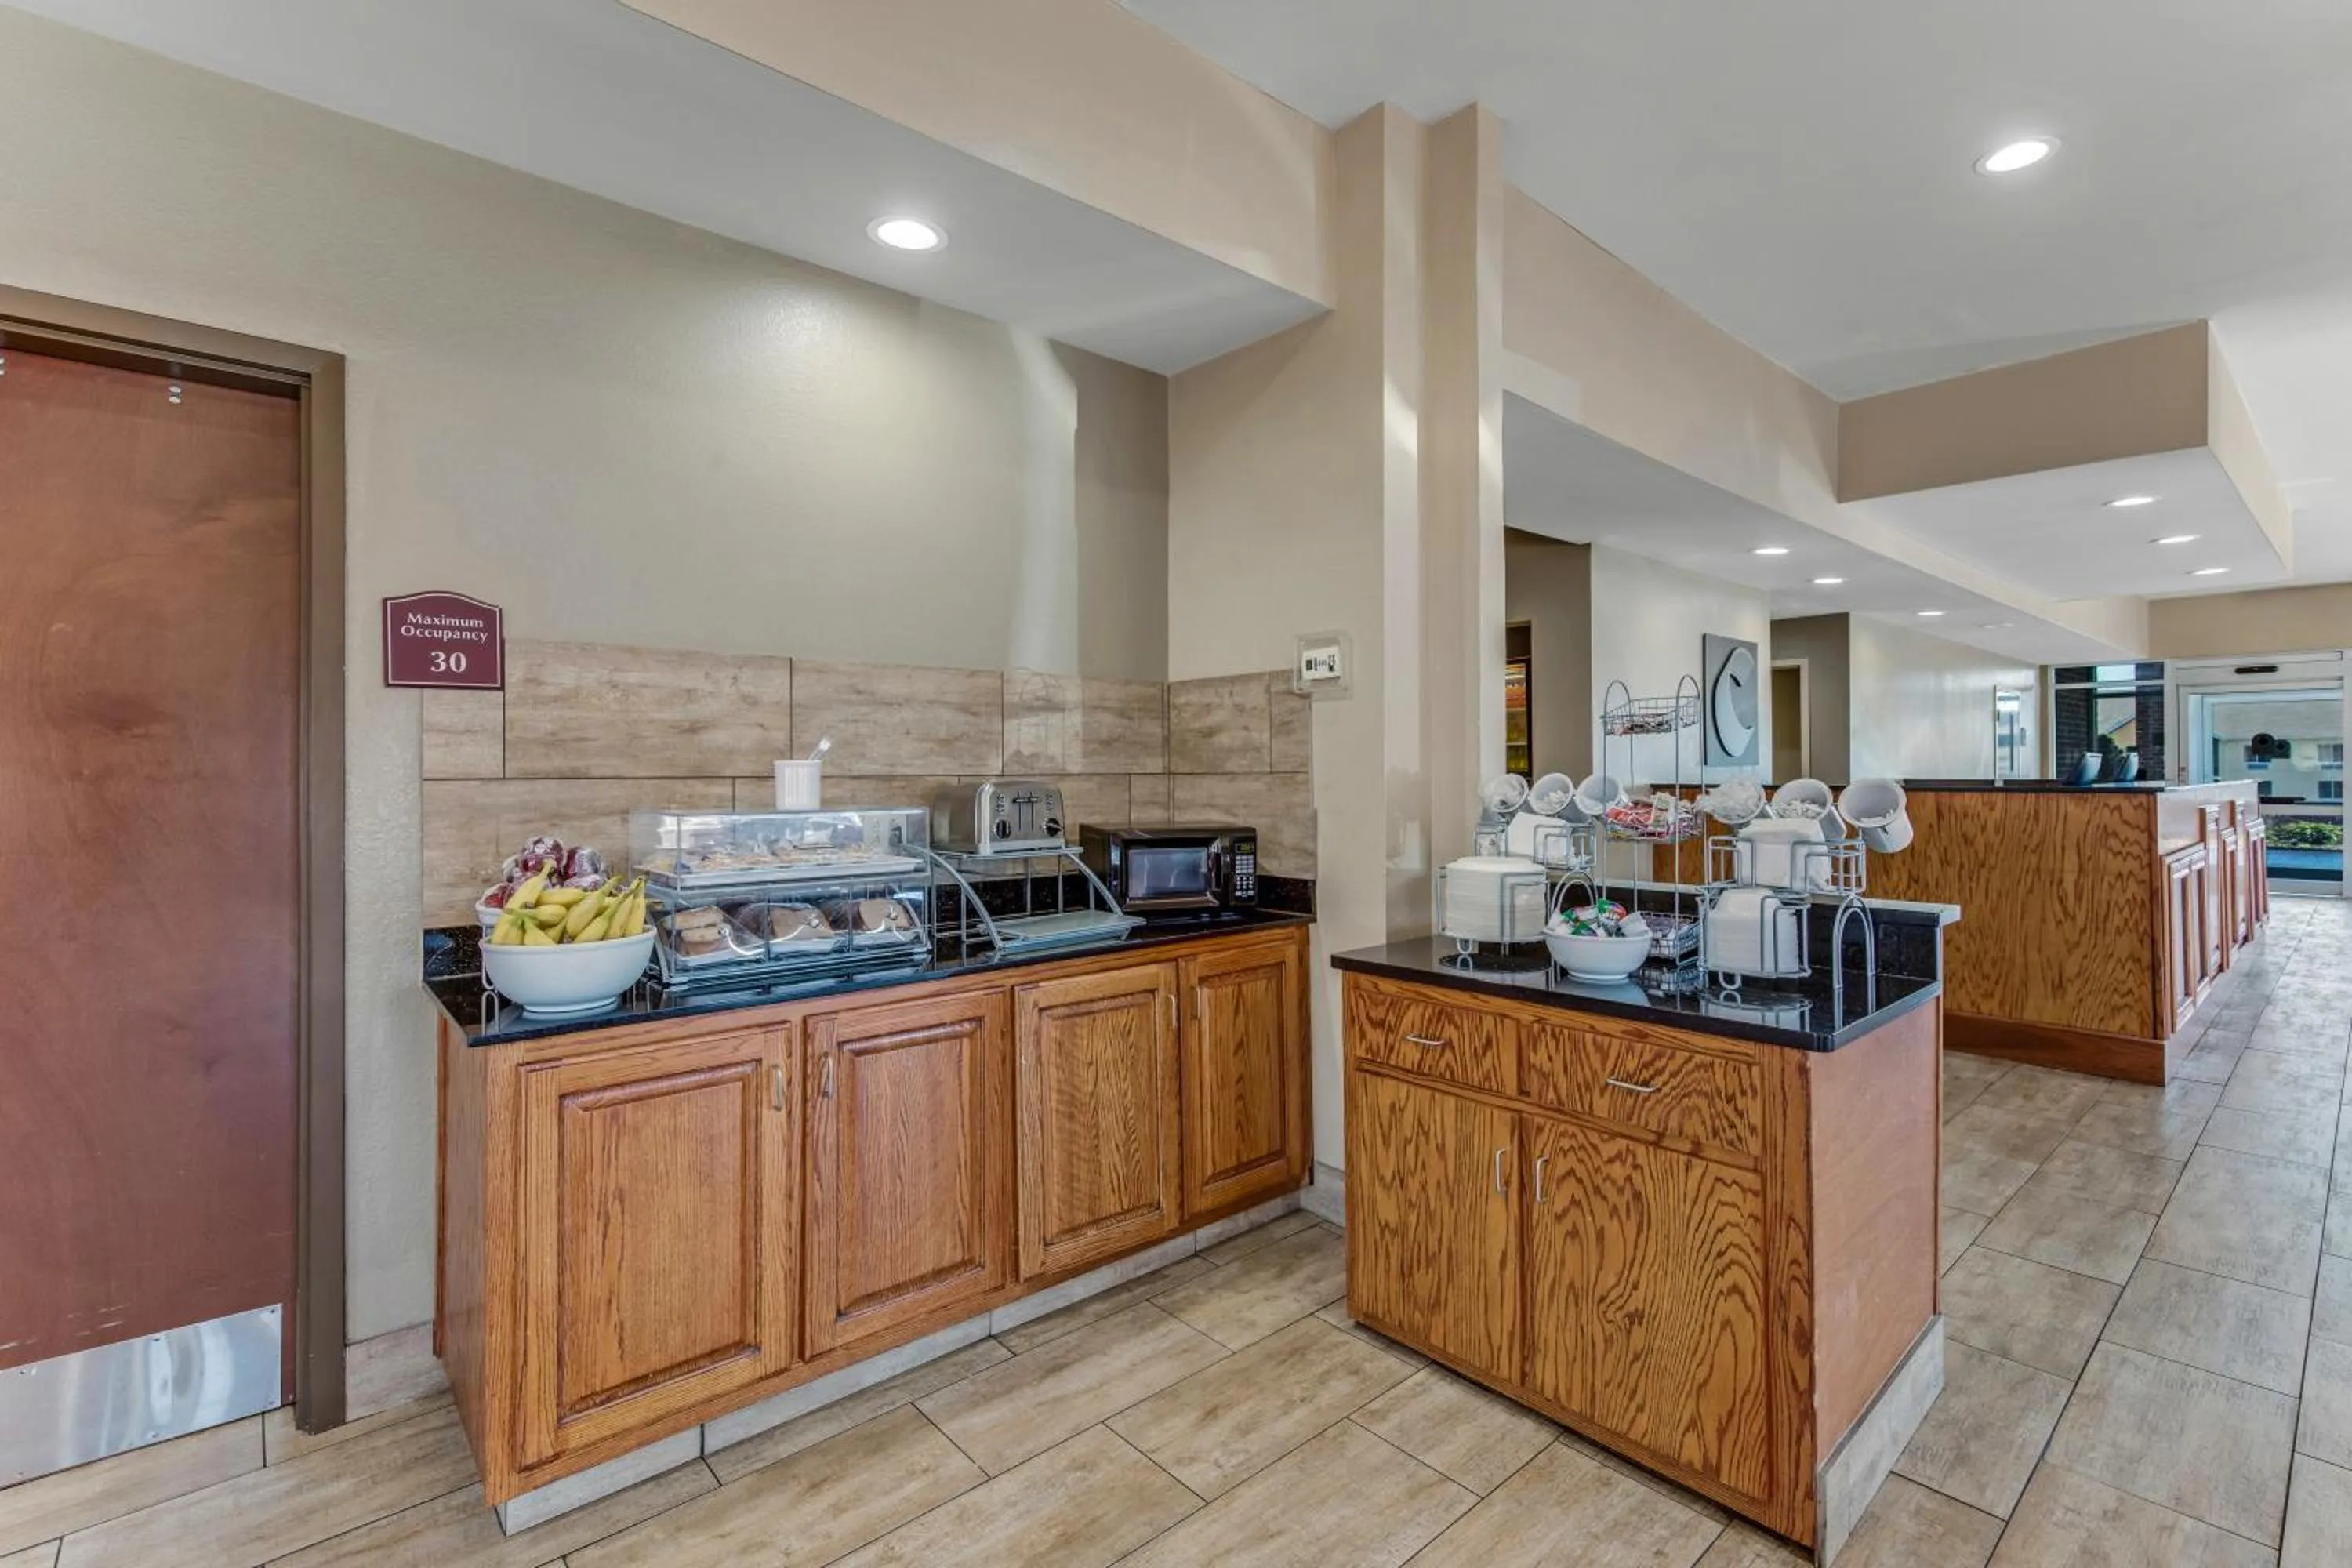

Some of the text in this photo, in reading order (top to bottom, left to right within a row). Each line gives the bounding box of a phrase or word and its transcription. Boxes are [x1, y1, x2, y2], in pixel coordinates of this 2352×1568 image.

[407, 612, 484, 627] Maximum
[401, 625, 488, 643] Occupancy
[430, 651, 466, 673] 30
